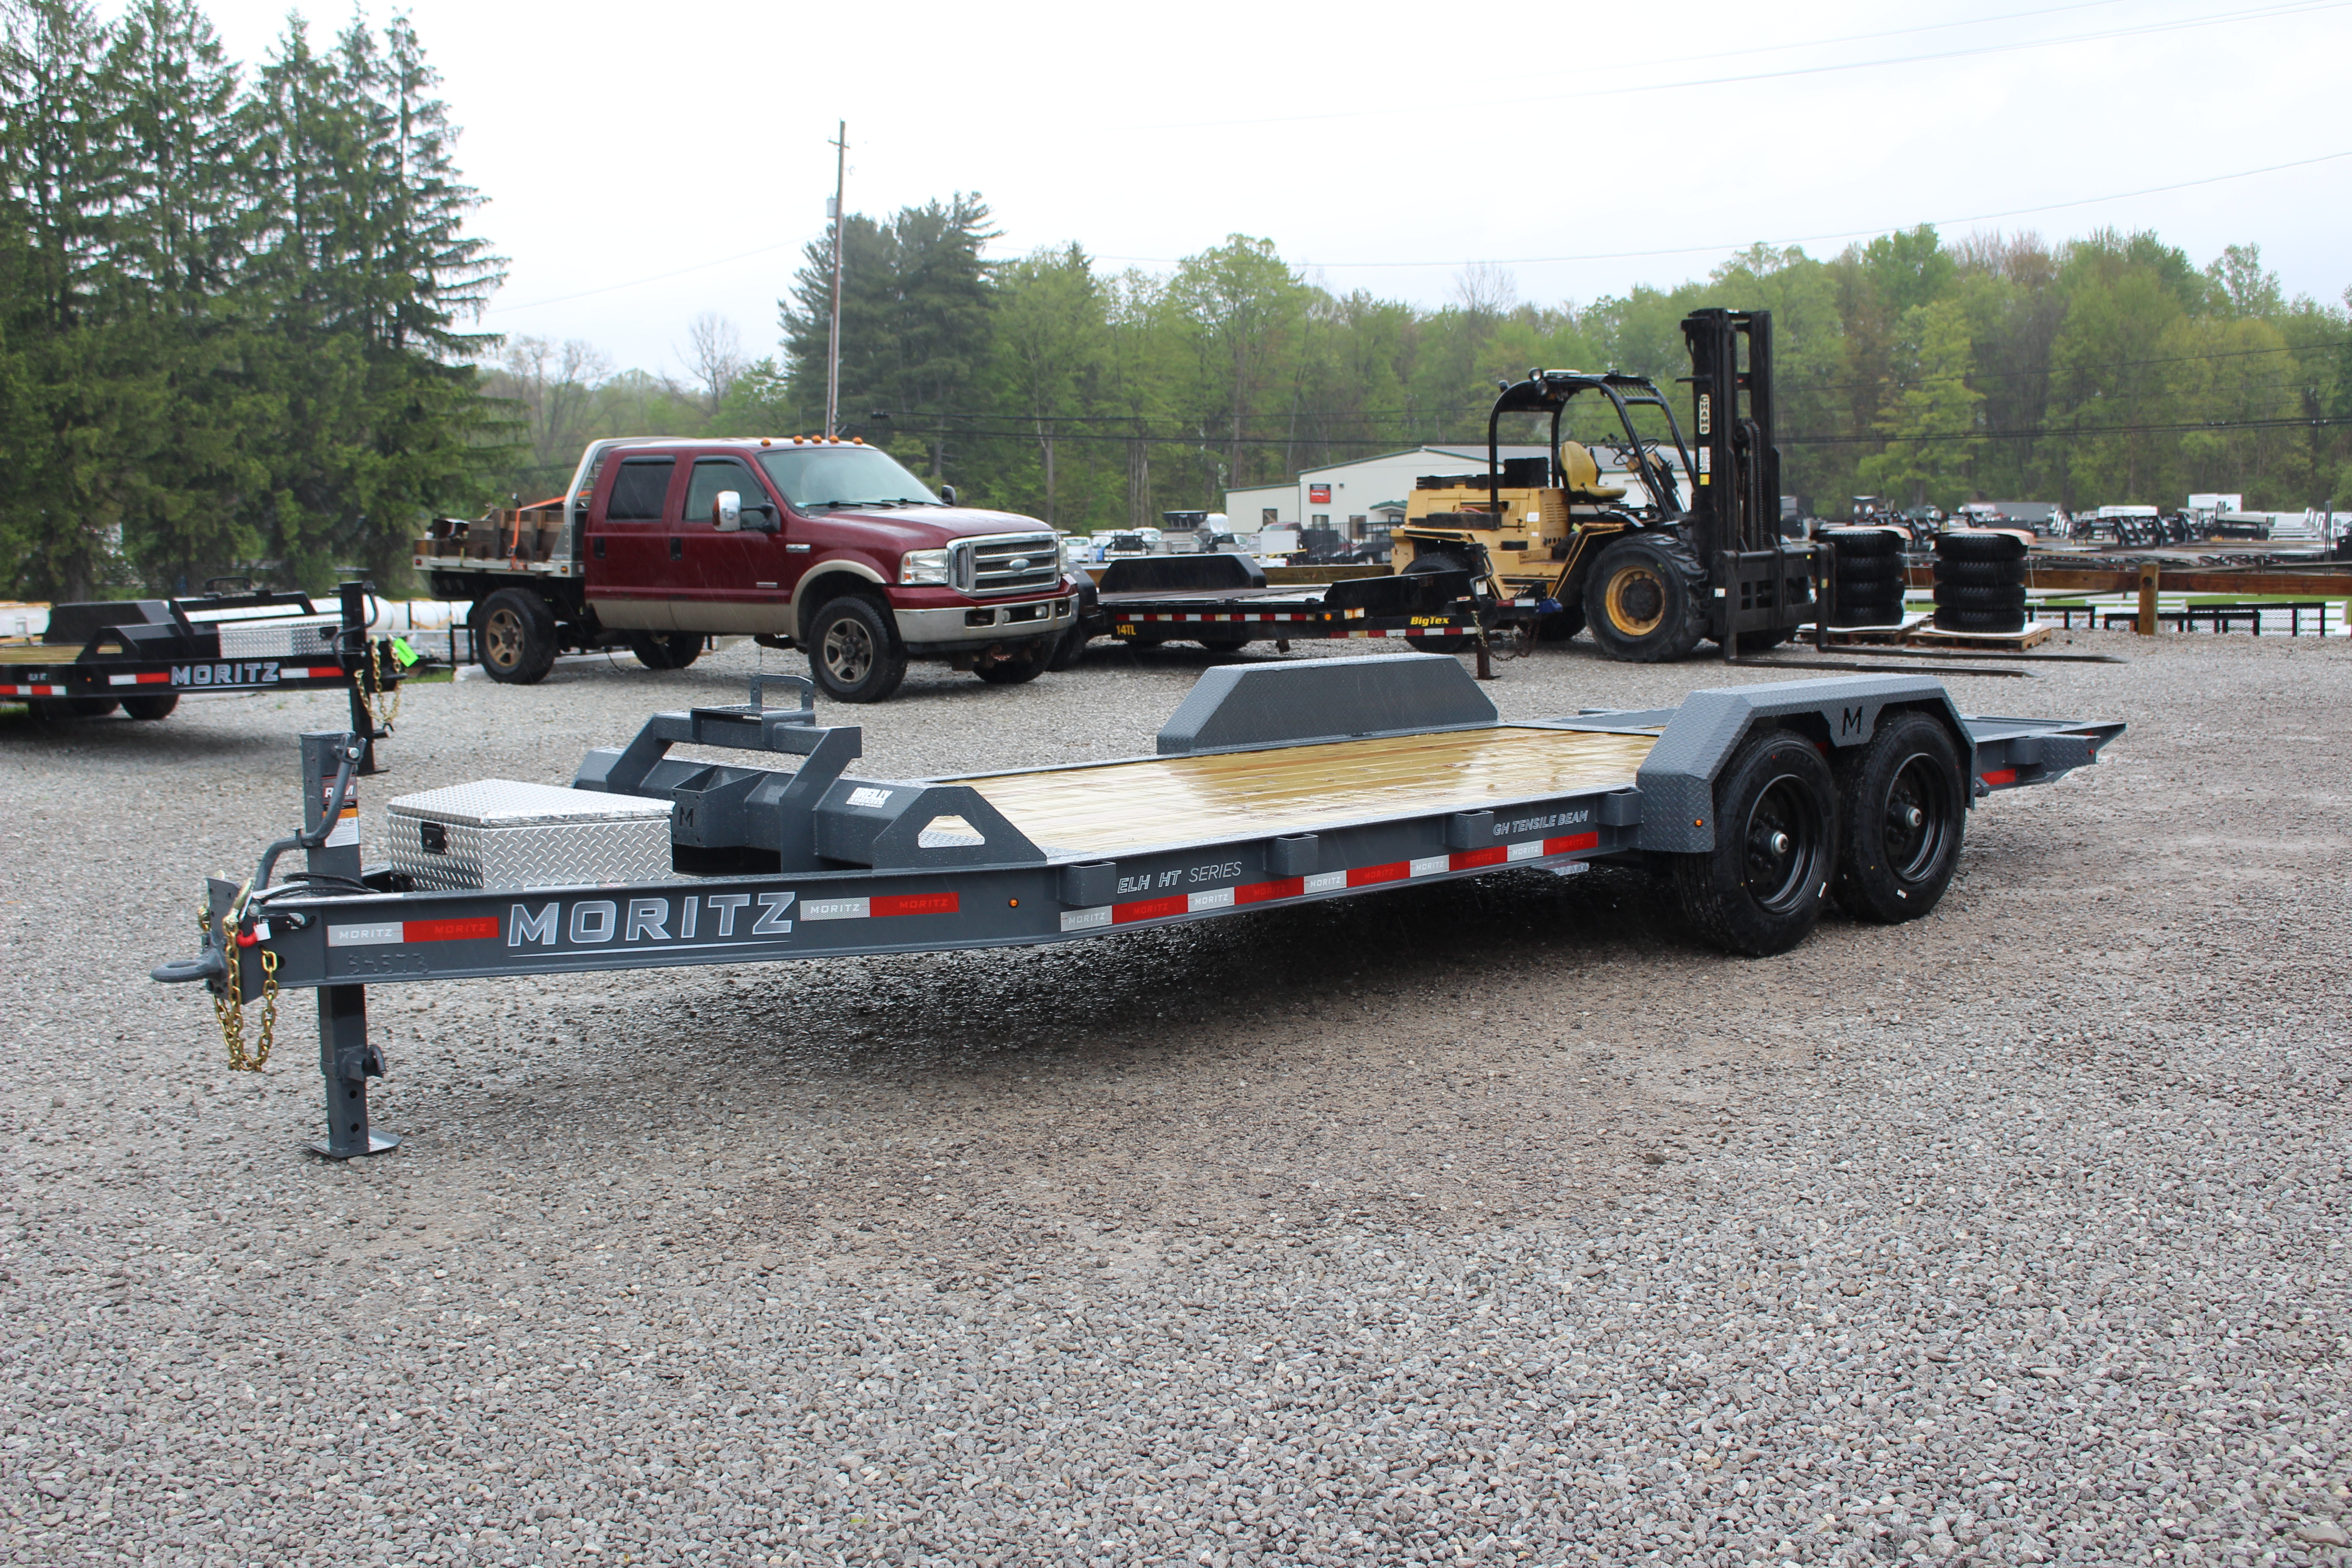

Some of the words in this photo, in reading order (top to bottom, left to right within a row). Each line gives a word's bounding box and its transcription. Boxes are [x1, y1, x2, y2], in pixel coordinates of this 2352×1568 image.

[1700, 396, 1709, 433] CHAMP
[1116, 624, 1137, 635] 14TL
[171, 662, 279, 686] MORITZ
[1842, 706, 1863, 736] M
[679, 807, 694, 828] M
[1493, 822, 1510, 836] GH
[1512, 815, 1557, 833] TENSILE
[1558, 810, 1589, 826] BEAM
[1512, 845, 1539, 856] MORITZ
[1416, 860, 1445, 872] MORITZ
[1117, 874, 1151, 894] ELH
[1158, 870, 1182, 887] HT
[1189, 861, 1242, 883] SERIES
[1364, 868, 1394, 879] MORITZ
[1310, 877, 1341, 887] MORITZ
[899, 898, 948, 909] MORITZ
[1195, 894, 1229, 906] MORITZ
[810, 903, 860, 914] MORITZ
[1134, 903, 1169, 915] MORITZ
[507, 892, 796, 947] MORITZ
[1068, 912, 1105, 925] MORITZ
[339, 928, 393, 939] MORITZ
[434, 923, 488, 934] MORITZ
